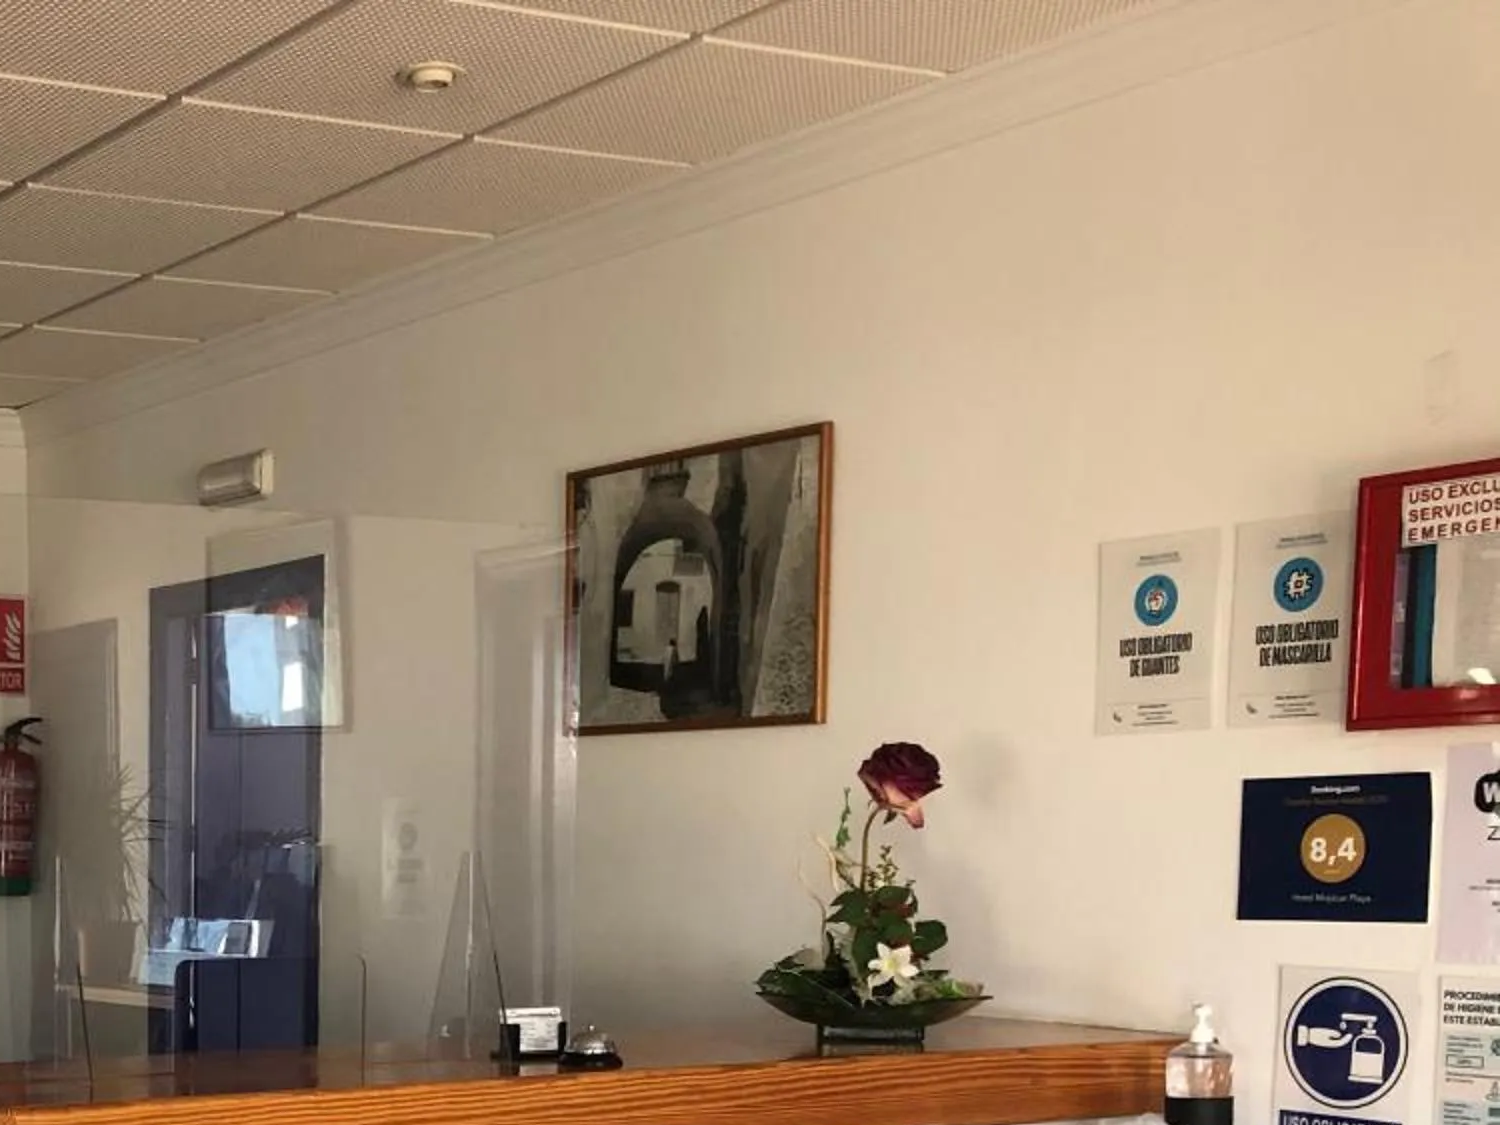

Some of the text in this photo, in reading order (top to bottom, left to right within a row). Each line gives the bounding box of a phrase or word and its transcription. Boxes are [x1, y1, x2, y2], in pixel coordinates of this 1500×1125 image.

[1409, 487, 1443, 505] USO
[1260, 647, 1271, 667] DE
[1129, 659, 1140, 677] DE
[1310, 837, 1357, 866] 8,4
